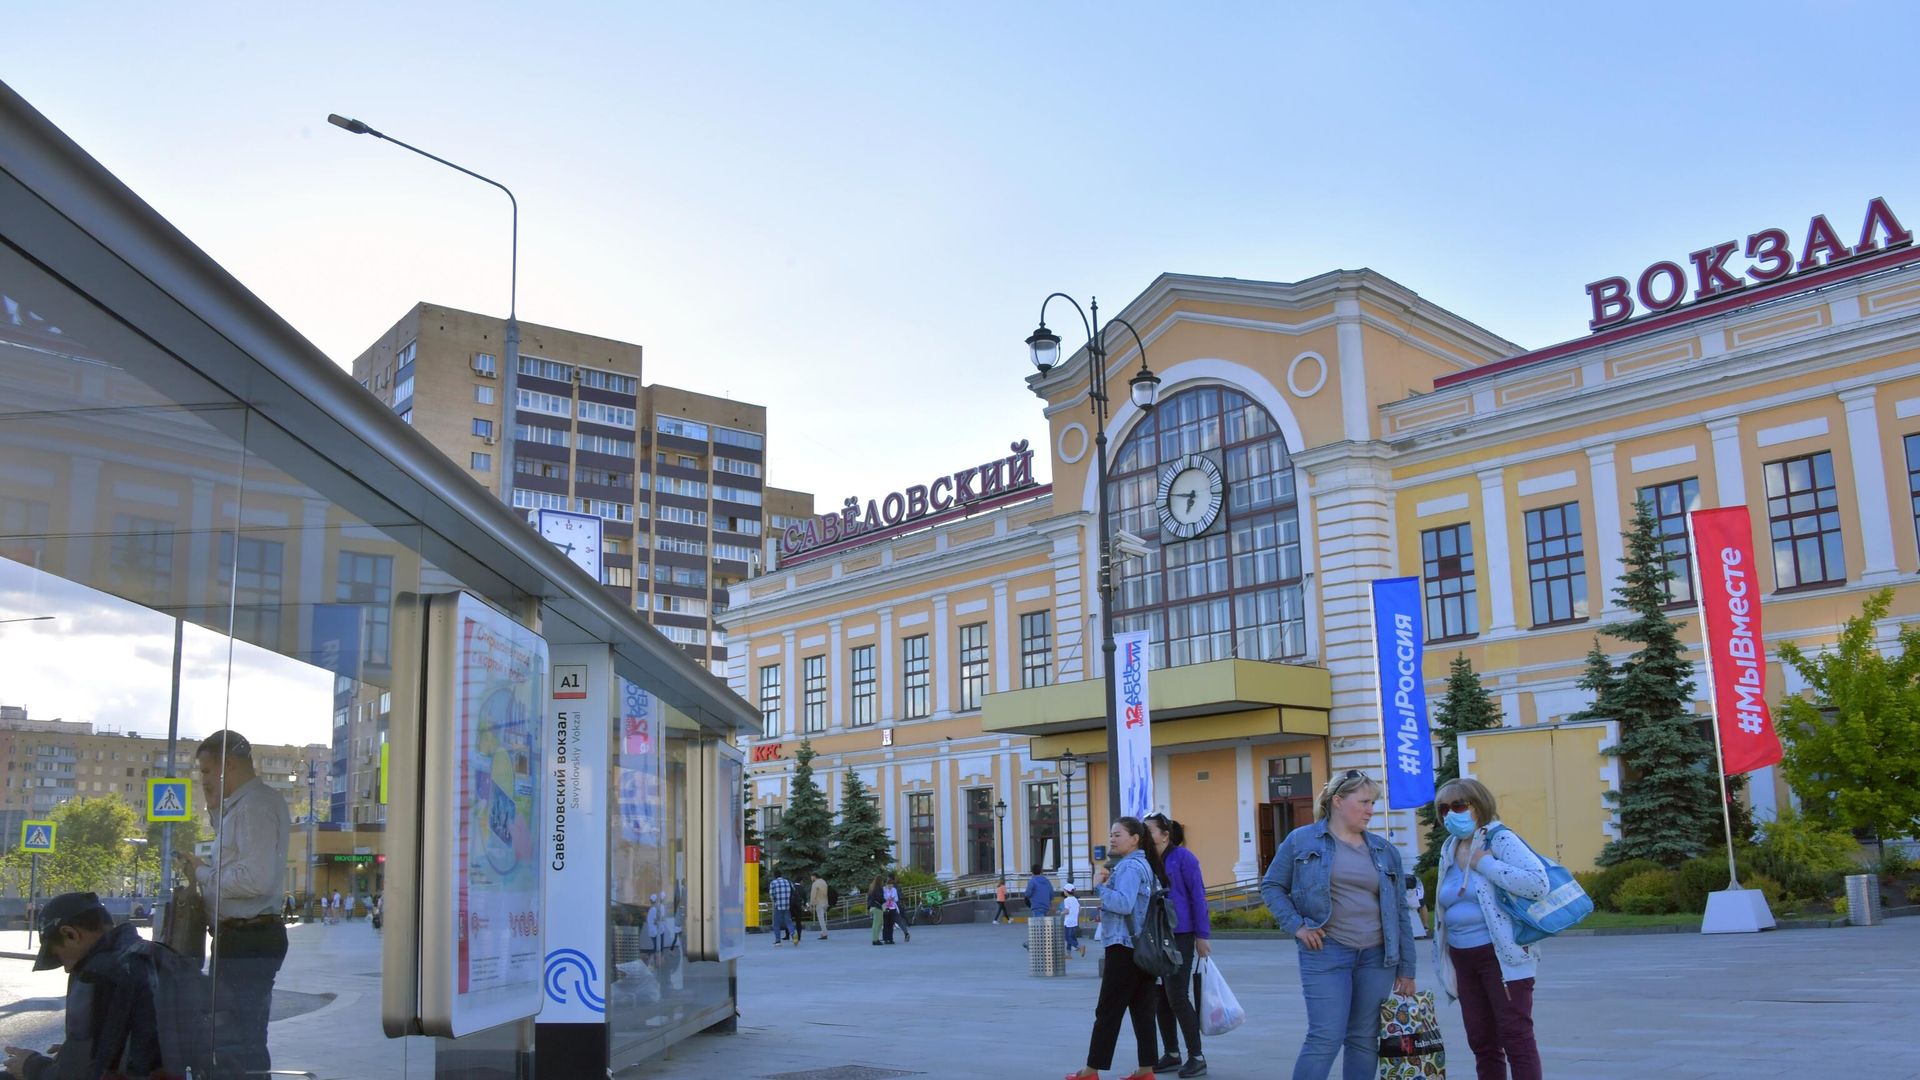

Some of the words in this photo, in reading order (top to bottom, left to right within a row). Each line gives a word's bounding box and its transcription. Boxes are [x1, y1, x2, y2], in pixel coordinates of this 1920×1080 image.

[1585, 196, 1913, 332] ВОКЗАЛ
[783, 439, 1035, 554] САВЁЛОВСКИЙ
[1721, 547, 1763, 735] #МыВместе
[1123, 663, 1135, 706] ДЕНЬ
[1131, 640, 1143, 705] РОССИИ
[557, 711, 568, 764] вокзал
[571, 711, 581, 744] Vokzal
[1126, 703, 1141, 729] 12
[570, 748, 582, 810] Savyolovskiy
[752, 743, 782, 762] KFC
[552, 769, 567, 872] Савёловский
